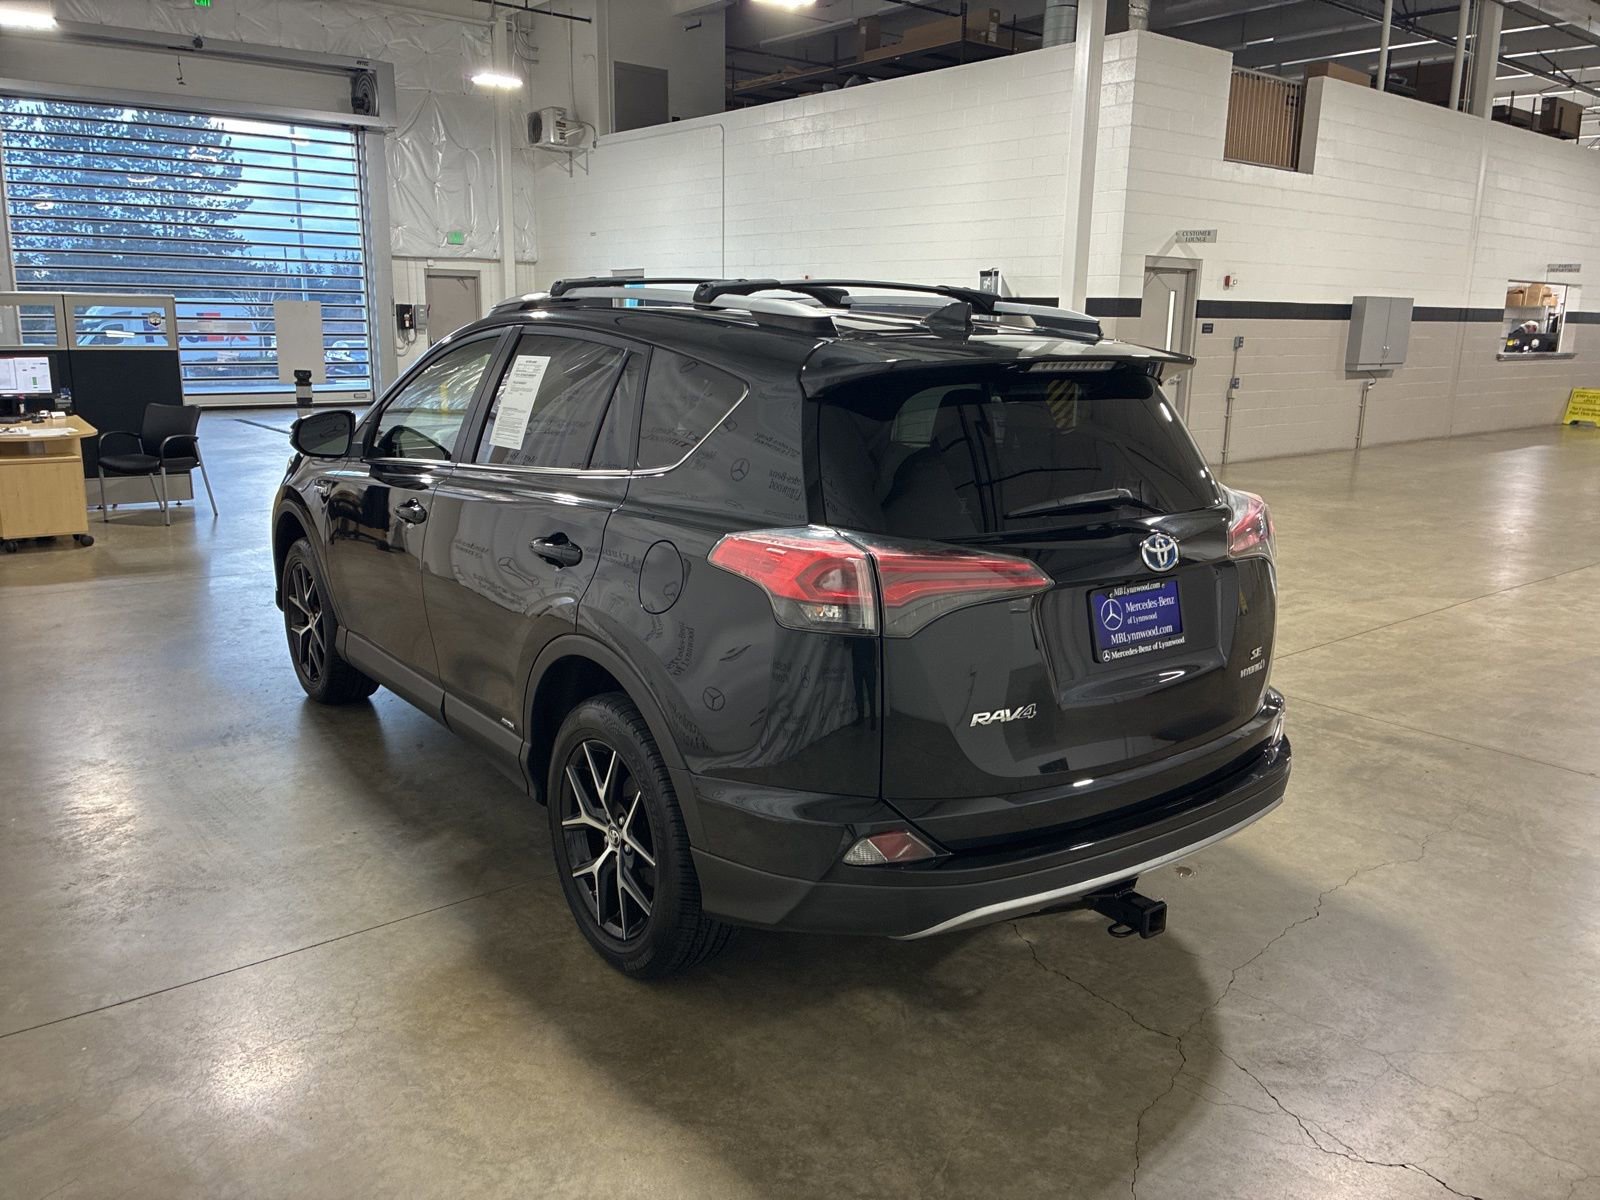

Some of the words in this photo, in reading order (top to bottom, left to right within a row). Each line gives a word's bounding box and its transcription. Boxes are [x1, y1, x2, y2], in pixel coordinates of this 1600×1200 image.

[1125, 596, 1175, 613] Mercedes-Benz
[1127, 616, 1133, 625] of
[1133, 612, 1157, 625] Lynnwood
[1111, 625, 1173, 645] MBLynnwood.com
[1111, 644, 1152, 660] Mercedes-Benz
[1153, 641, 1159, 650] of
[1158, 636, 1185, 650] Lynnwood
[969, 703, 1036, 728] RAV4
